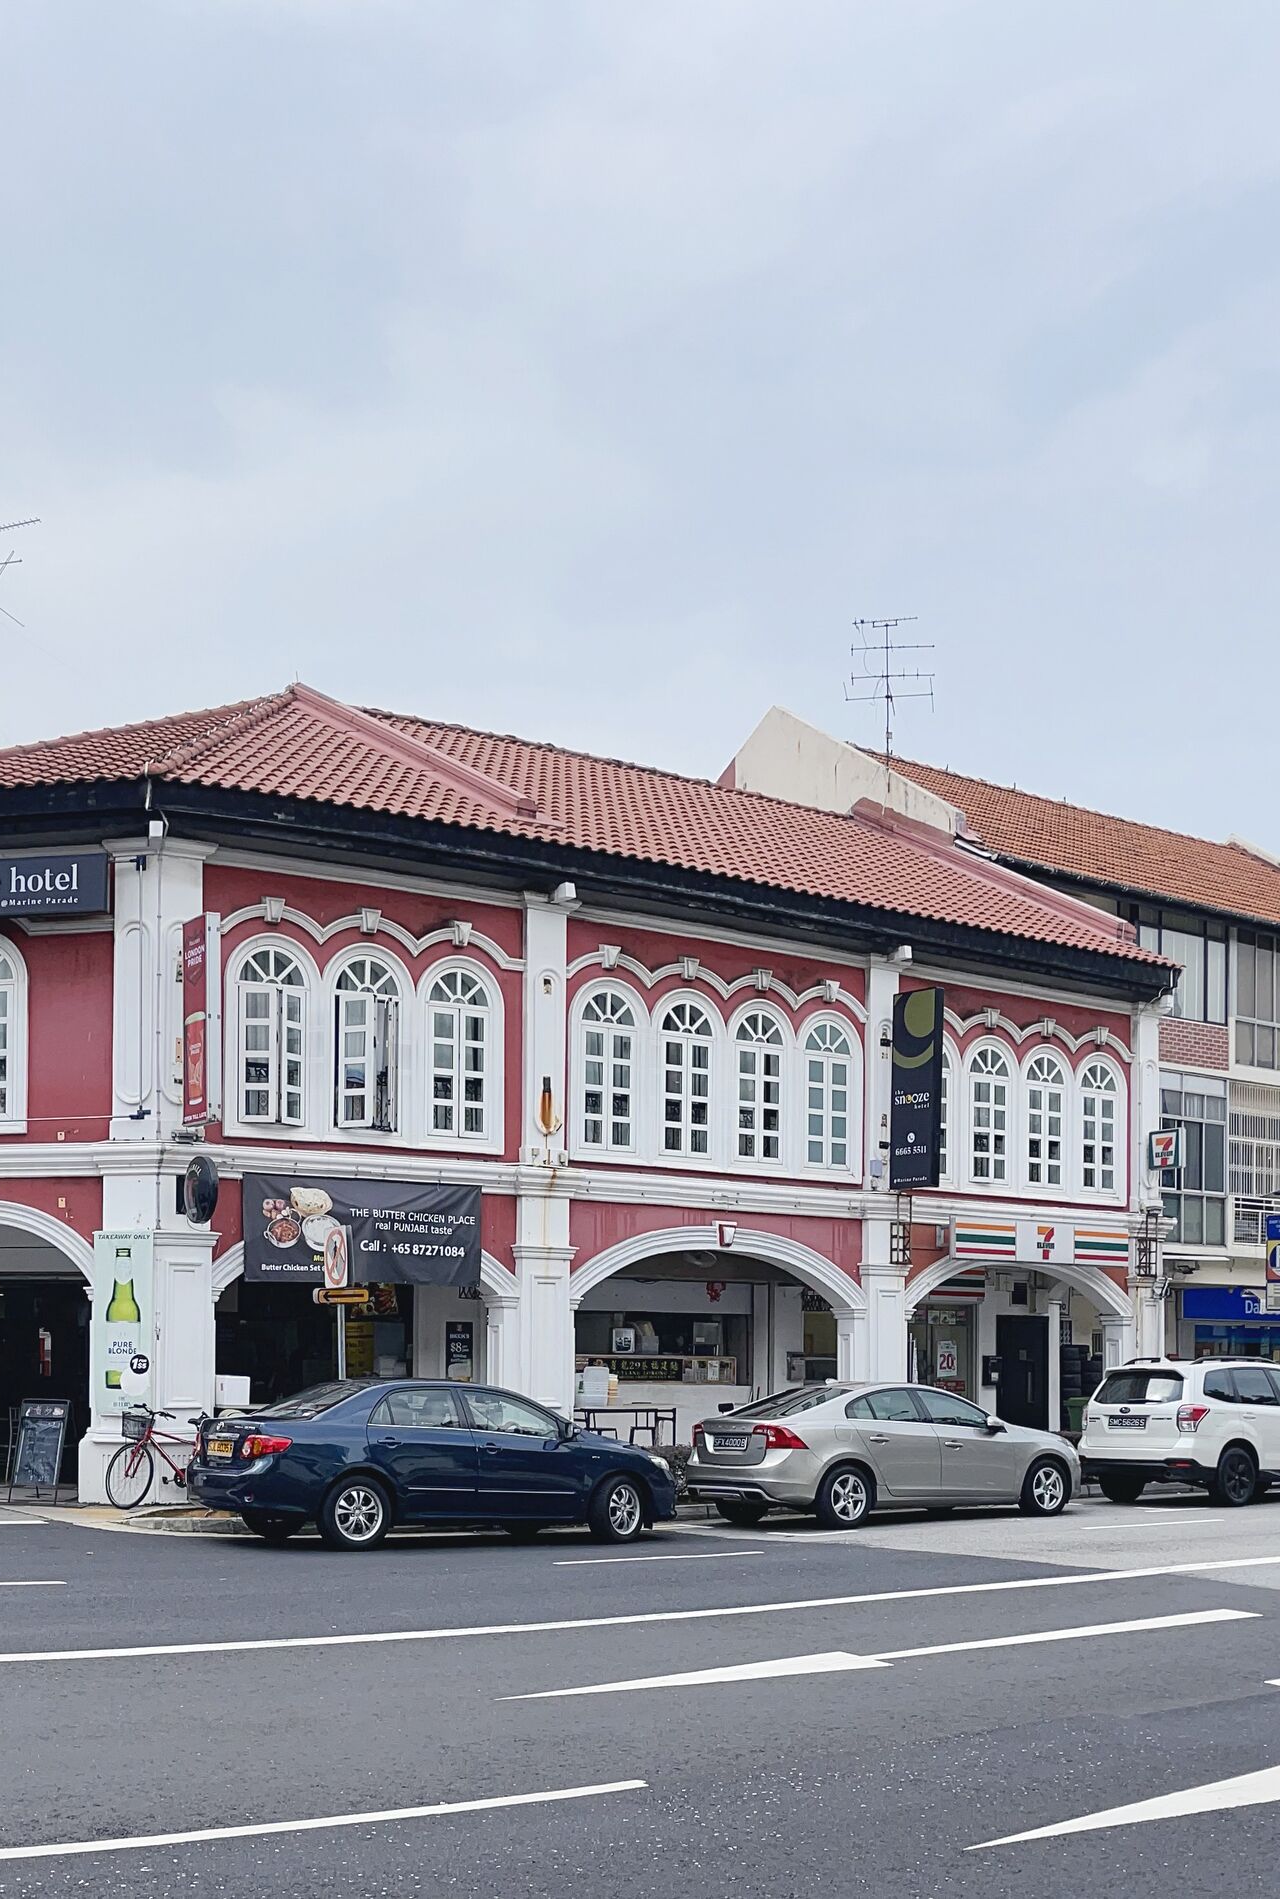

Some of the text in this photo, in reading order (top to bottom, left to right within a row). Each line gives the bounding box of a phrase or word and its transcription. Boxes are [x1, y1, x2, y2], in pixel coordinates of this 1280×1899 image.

[10, 863, 78, 893] hotel
[0, 896, 79, 908] @Marine Parade
[184, 943, 206, 960] LONDON
[187, 954, 202, 968] PRIDE
[894, 1092, 930, 1106] snooze
[895, 1145, 927, 1156] 6665 5511
[1155, 1136, 1173, 1168] 7
[349, 1208, 476, 1225] THE BUTTER CHICKEN PLACE
[375, 1221, 453, 1235] real PUNJABI taste
[360, 1239, 380, 1252] Call
[391, 1243, 411, 1254] +65
[412, 1243, 466, 1258] 87271084
[1037, 1225, 1055, 1260] 7
[261, 1264, 321, 1272] Butter Chicken Set
[108, 1347, 137, 1355] BLONDE
[450, 1341, 462, 1353] $8
[1109, 1418, 1145, 1426] SMC5626S
[714, 1437, 746, 1447] SFX4000B
